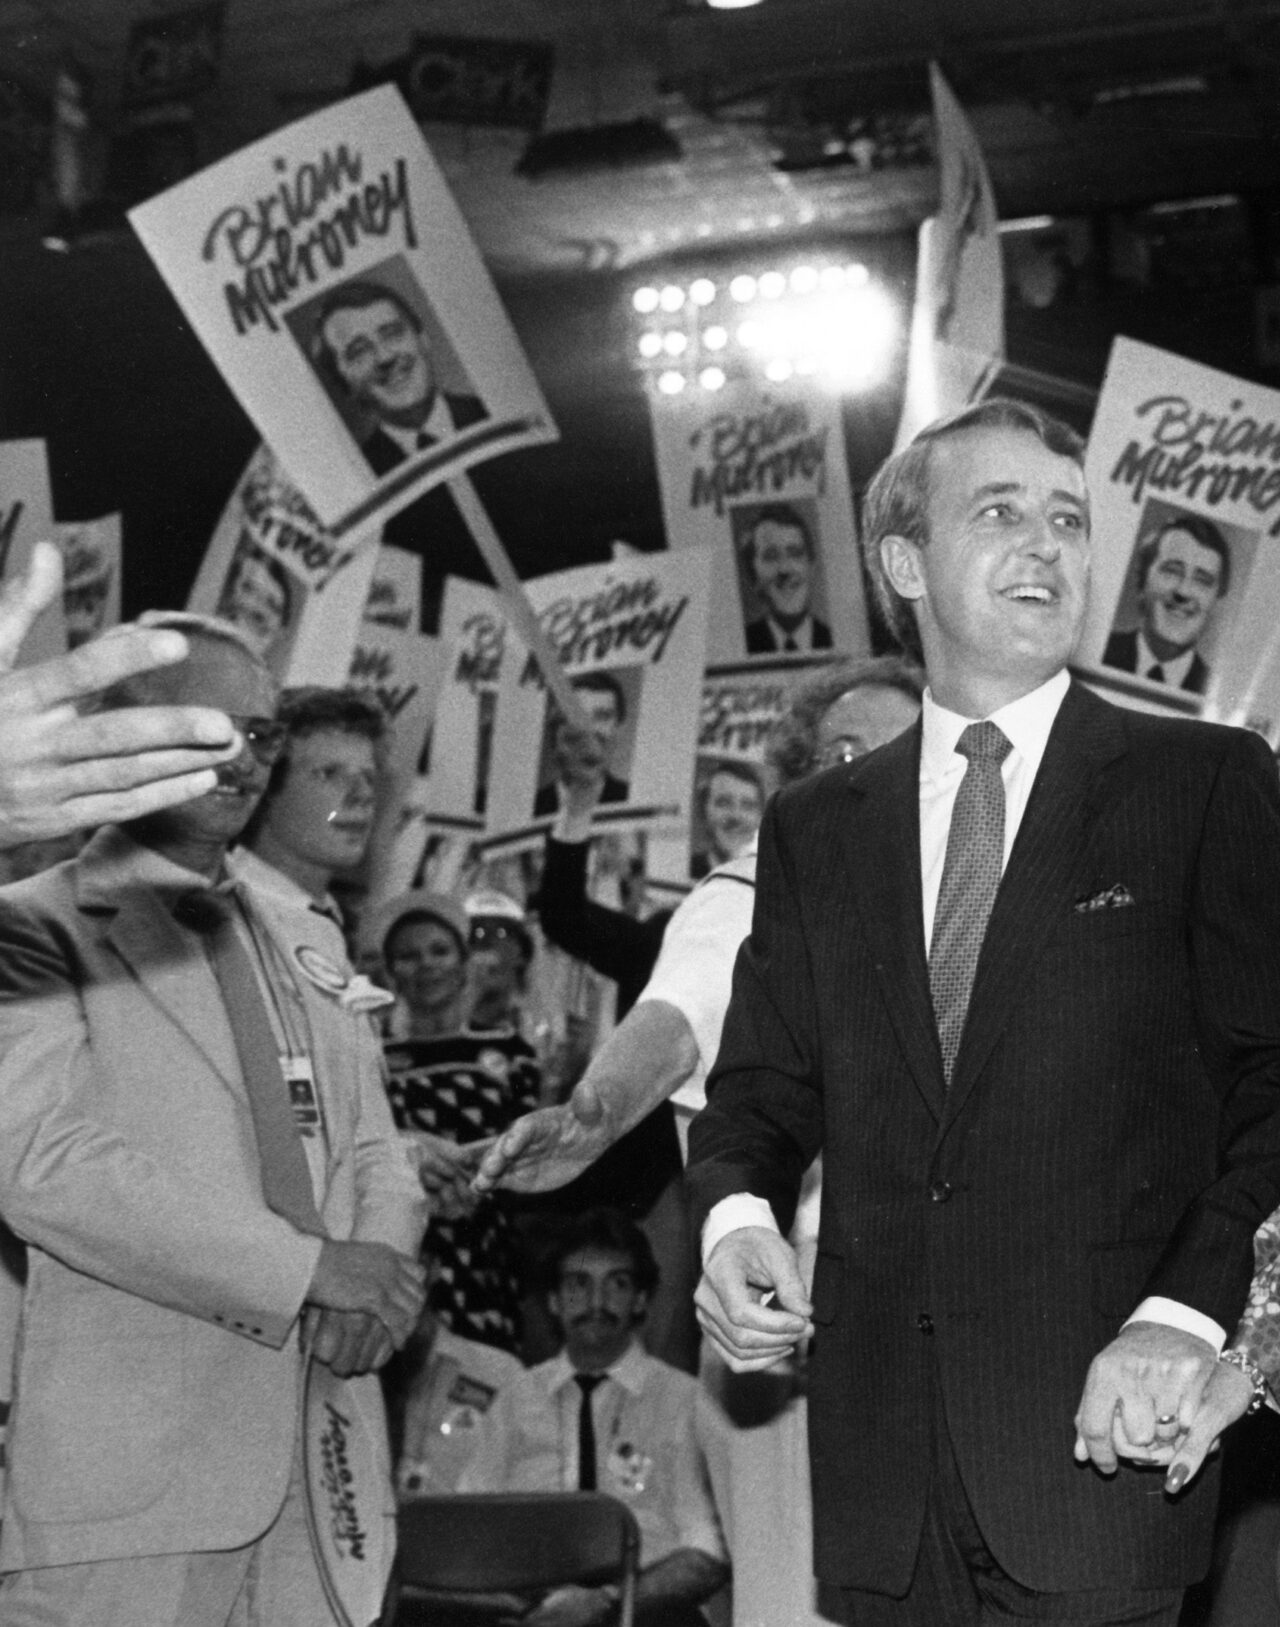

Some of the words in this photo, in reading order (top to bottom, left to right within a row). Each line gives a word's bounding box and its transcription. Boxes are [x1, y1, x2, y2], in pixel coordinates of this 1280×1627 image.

[203, 144, 362, 266] Brian
[224, 158, 418, 335] Mulroney
[689, 393, 810, 462] Brian
[690, 424, 831, 517] Mulroney
[519, 596, 689, 690] Mlroney
